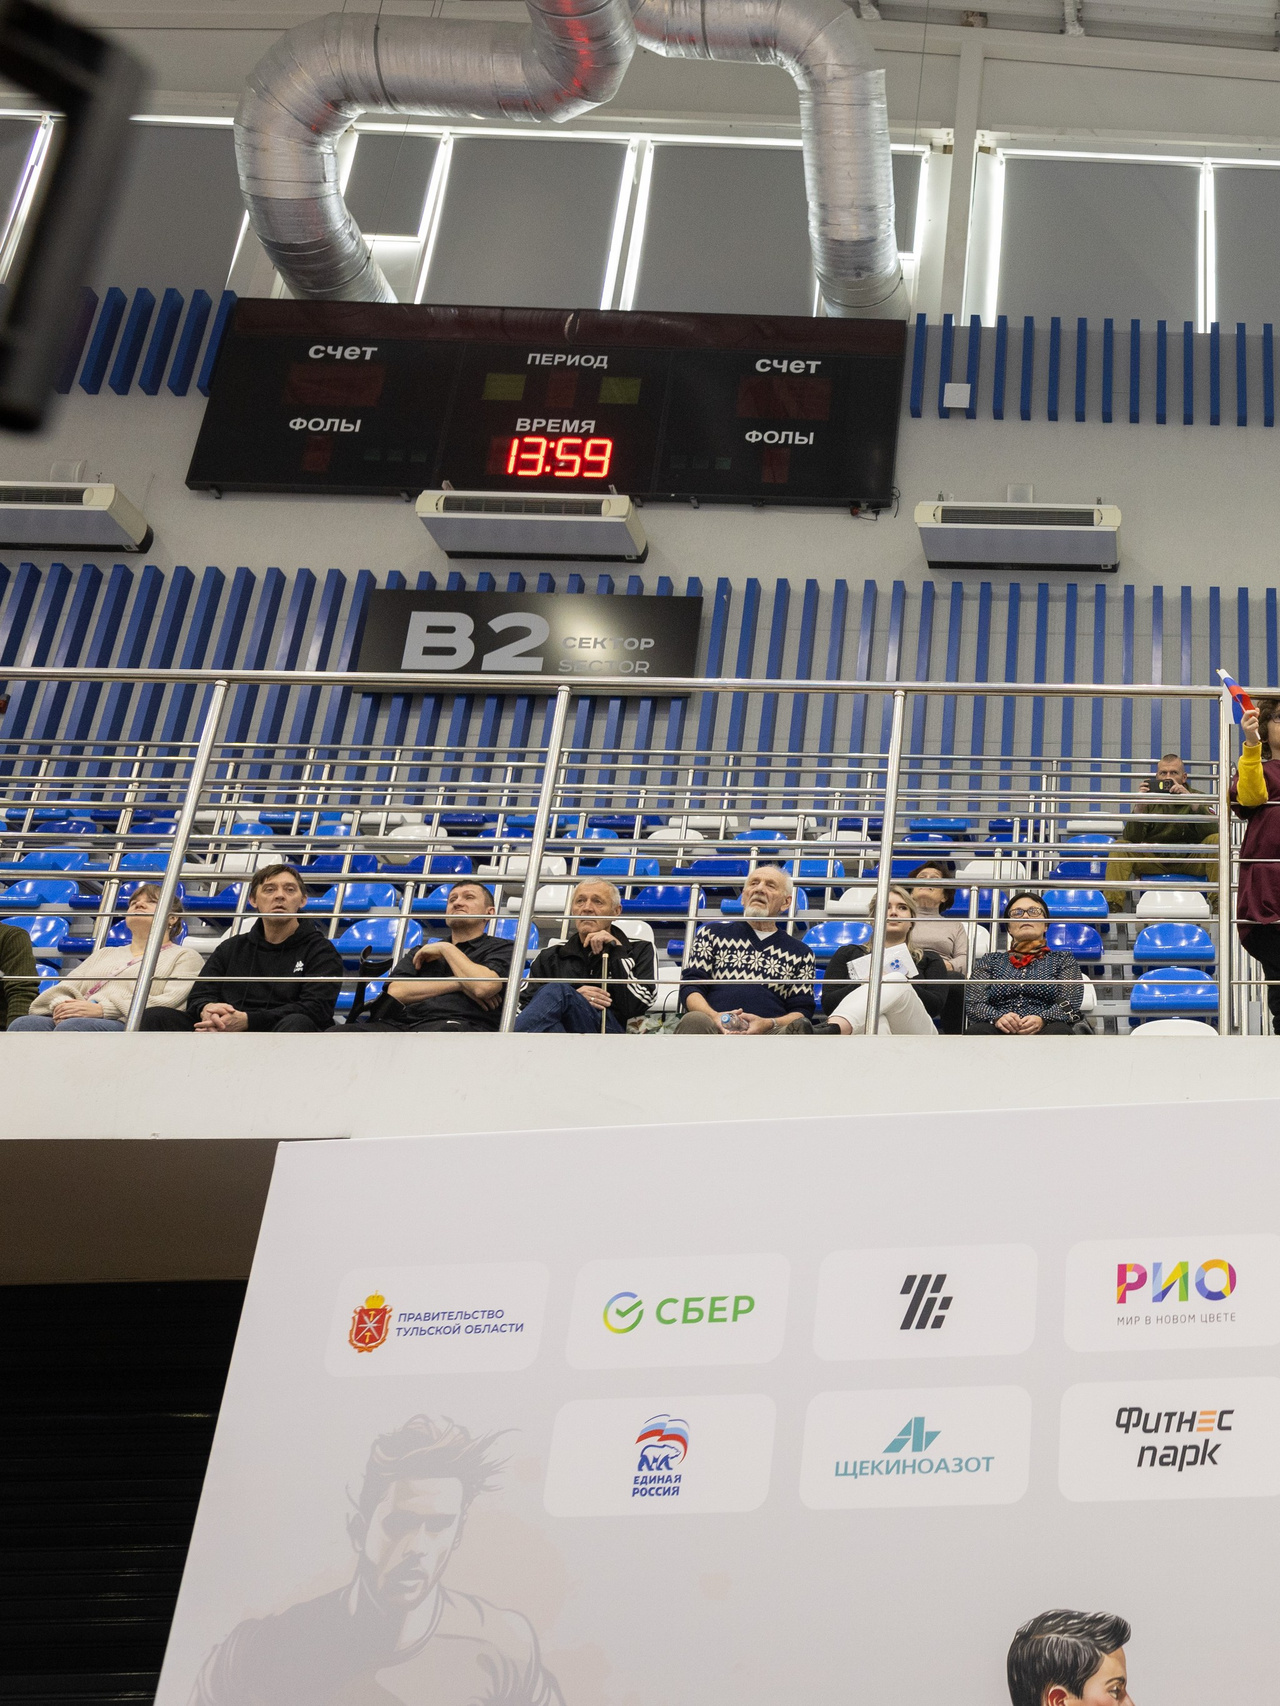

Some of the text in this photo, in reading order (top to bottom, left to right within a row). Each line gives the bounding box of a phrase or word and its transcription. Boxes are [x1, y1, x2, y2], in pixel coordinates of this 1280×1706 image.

[308, 345, 378, 360] счет
[527, 353, 609, 369] ПЕРИОД
[755, 358, 822, 374] счет
[289, 417, 362, 433] ФОЛЫ
[515, 418, 596, 434] ВРЕМЯ
[744, 430, 815, 446] ФОЛЫ
[506, 436, 613, 478] 13:59
[562, 636, 655, 651] СЕКТОР
[558, 659, 650, 674] SECTOR
[1116, 1258, 1237, 1304] РИО
[398, 1309, 505, 1323] ПРАВИТЕЛЬСТВО
[655, 1295, 755, 1325] СБЕР
[1117, 1312, 1236, 1326] МИР В НОВОМ ЦВЕТЕ
[395, 1322, 524, 1337] ТУЛЬСКОЙ ОБЛАСТИ
[1137, 1438, 1222, 1472] парк
[834, 1455, 995, 1479] ЩЕКИНОАЗОТ
[633, 1474, 682, 1486] ЕДИНАЯ
[632, 1486, 680, 1498] РОССИЯ
